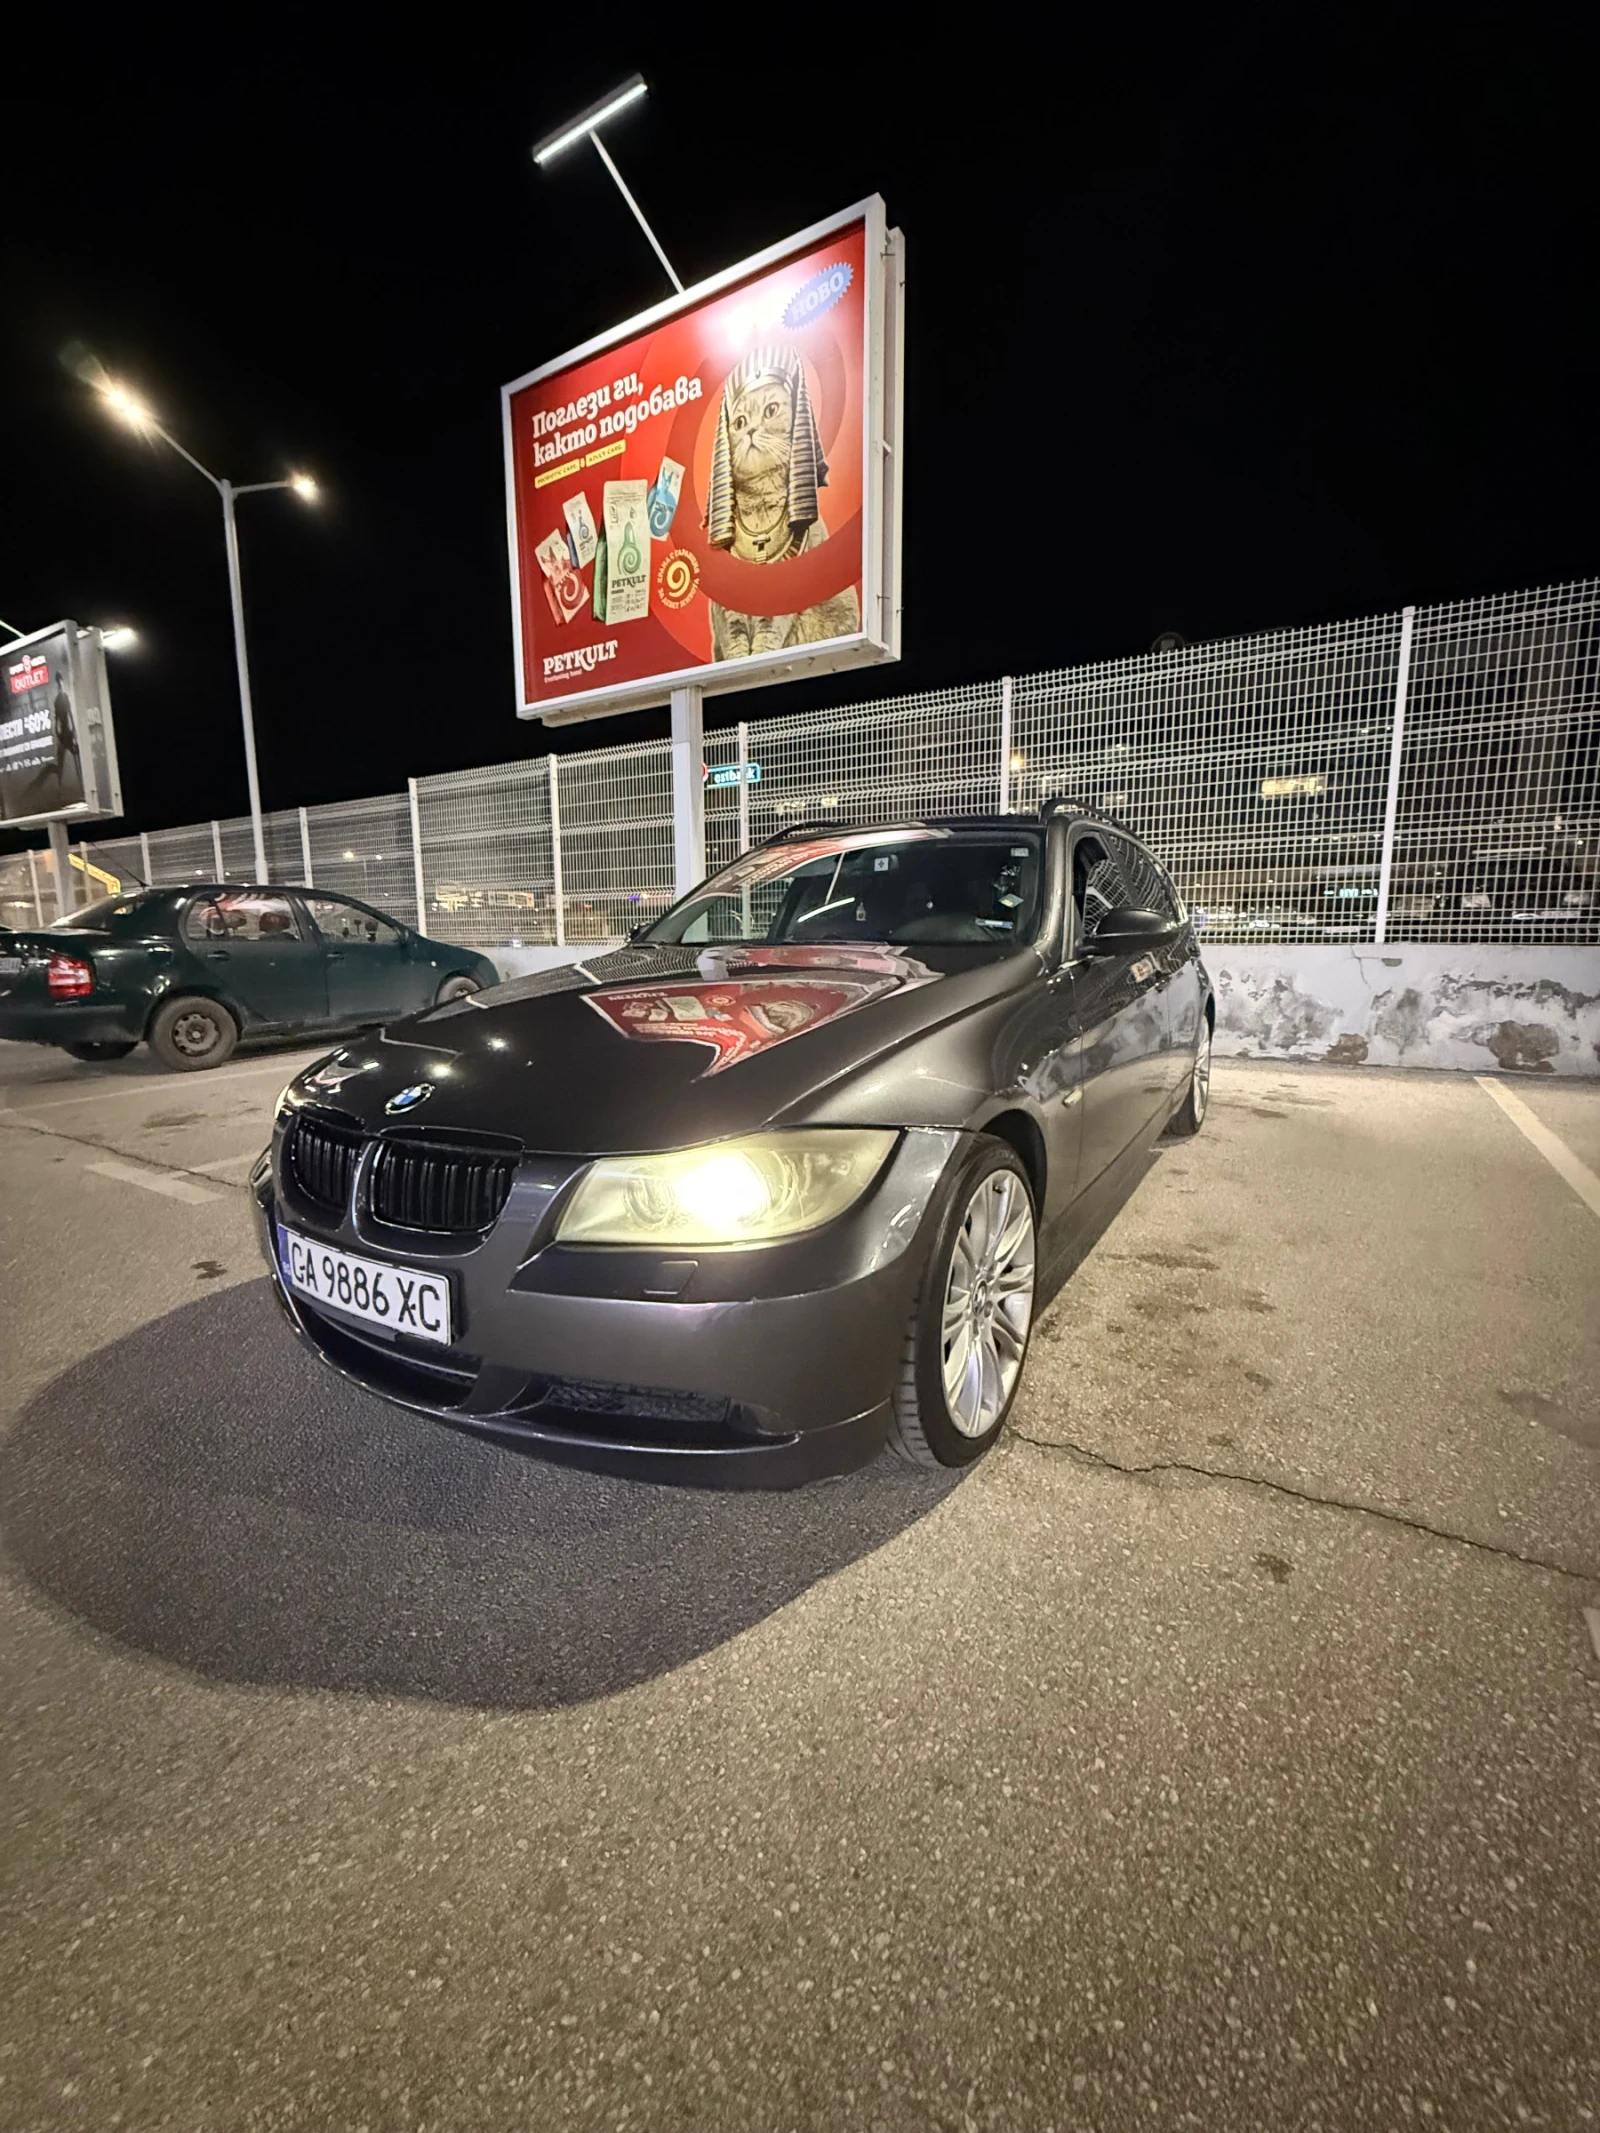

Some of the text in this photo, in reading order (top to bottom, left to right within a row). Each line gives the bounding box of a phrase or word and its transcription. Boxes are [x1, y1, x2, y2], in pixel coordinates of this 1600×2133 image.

[790, 271, 844, 322] НОВО
[532, 372, 644, 439] Поглези ги,
[533, 375, 703, 467] както подобава
[611, 574, 646, 589] PETKULT
[14, 669, 45, 691] OUTLET
[543, 639, 618, 675] PETKULT
[291, 1242, 441, 1332] CA 9886 XC
